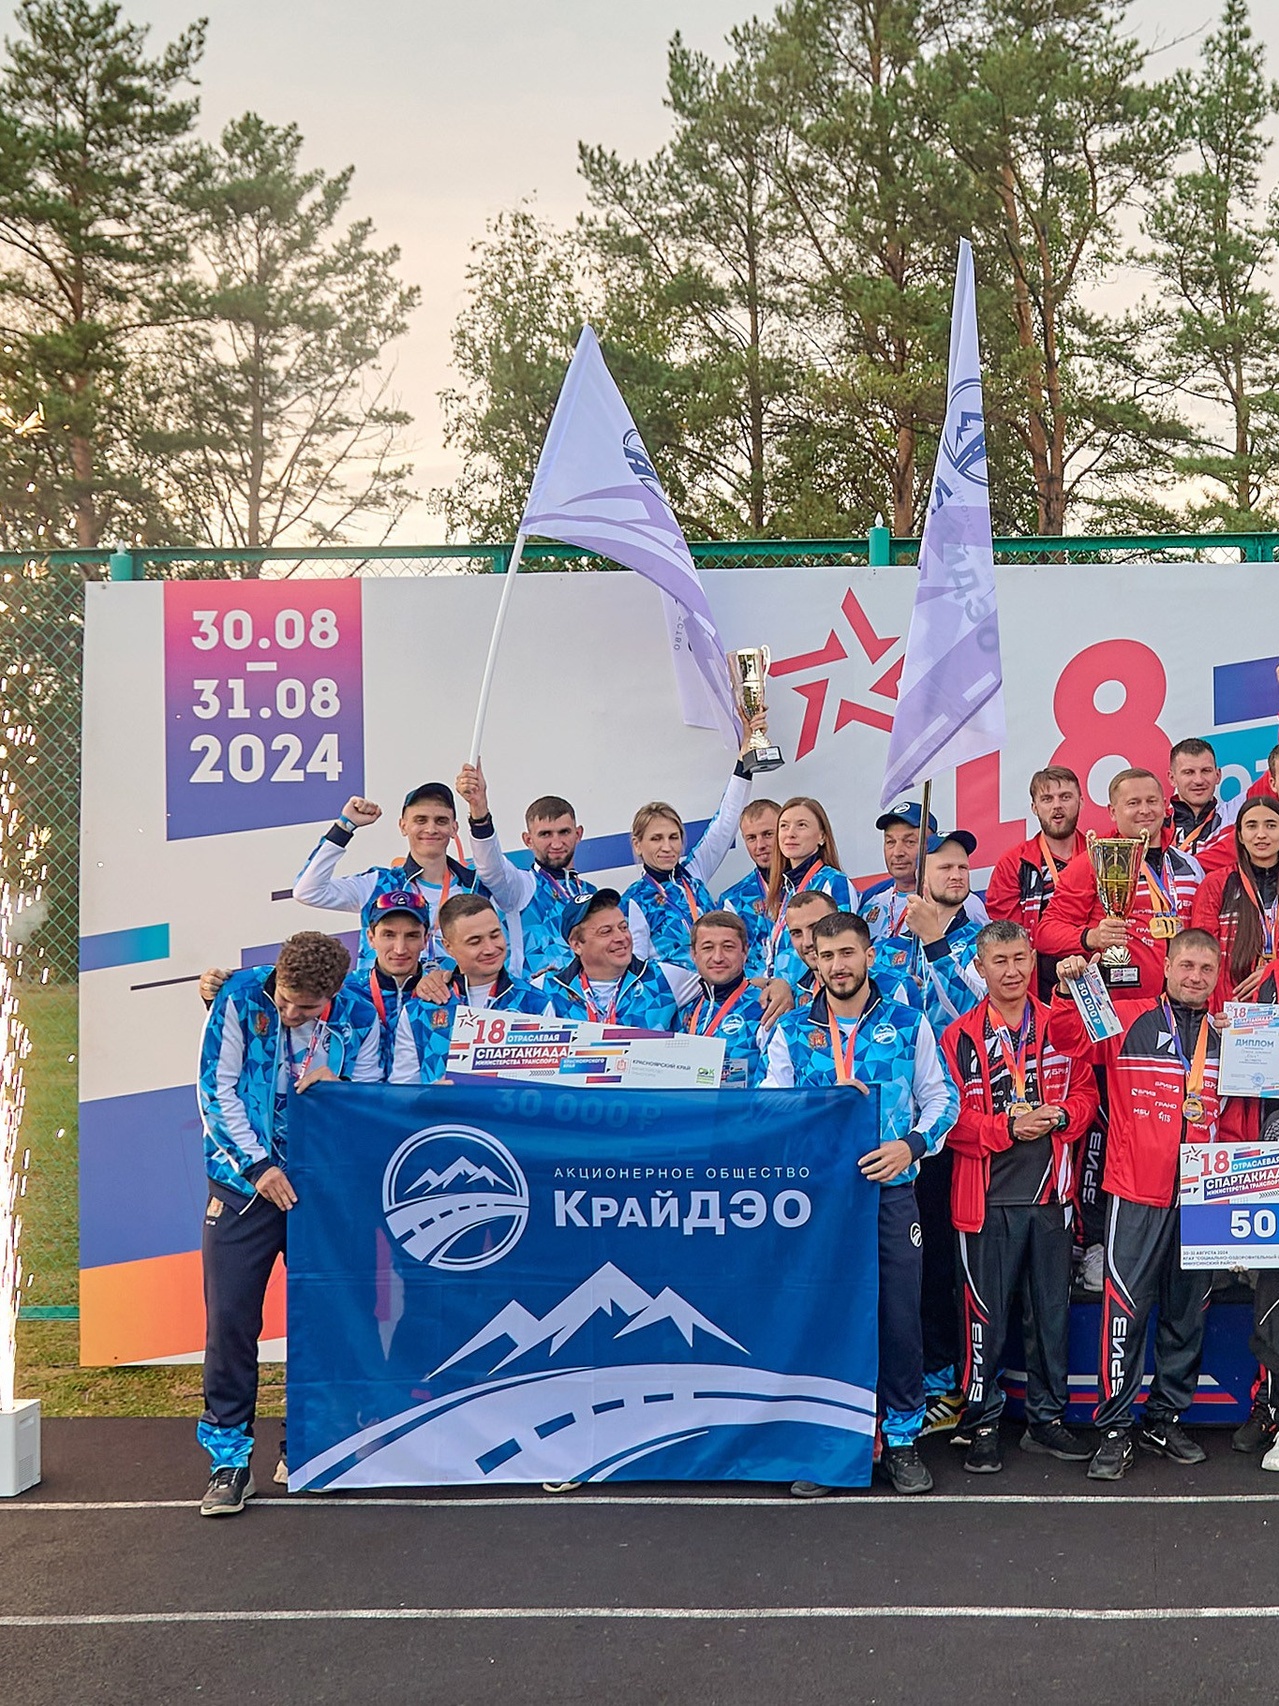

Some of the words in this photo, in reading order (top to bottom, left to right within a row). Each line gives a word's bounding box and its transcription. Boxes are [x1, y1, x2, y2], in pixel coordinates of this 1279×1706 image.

[191, 609, 340, 650] 30.08
[191, 678, 341, 719] 31.08
[189, 733, 343, 783] 2024
[1233, 1007, 1247, 1018] 18
[473, 1018, 506, 1044] 18
[507, 1033, 560, 1043] ОТРАСЛЕВАЯ
[1235, 1039, 1274, 1048] ДИПЛОМ
[476, 1046, 568, 1060] СПАРТАКИАДА
[521, 1057, 559, 1065] ТРАНСПОРТА
[554, 1166, 696, 1180] АКЦИОНЕРНОЕ
[705, 1166, 811, 1180] ОБЩЕСТВО
[1083, 1132, 1102, 1204] БРИЗ
[1201, 1150, 1230, 1176] 18
[1206, 1185, 1249, 1197] МИНИСТЕРСТВА
[1230, 1209, 1277, 1238] 50
[969, 1322, 983, 1402] БРИЗ
[1111, 1316, 1128, 1398] БРИЗ
